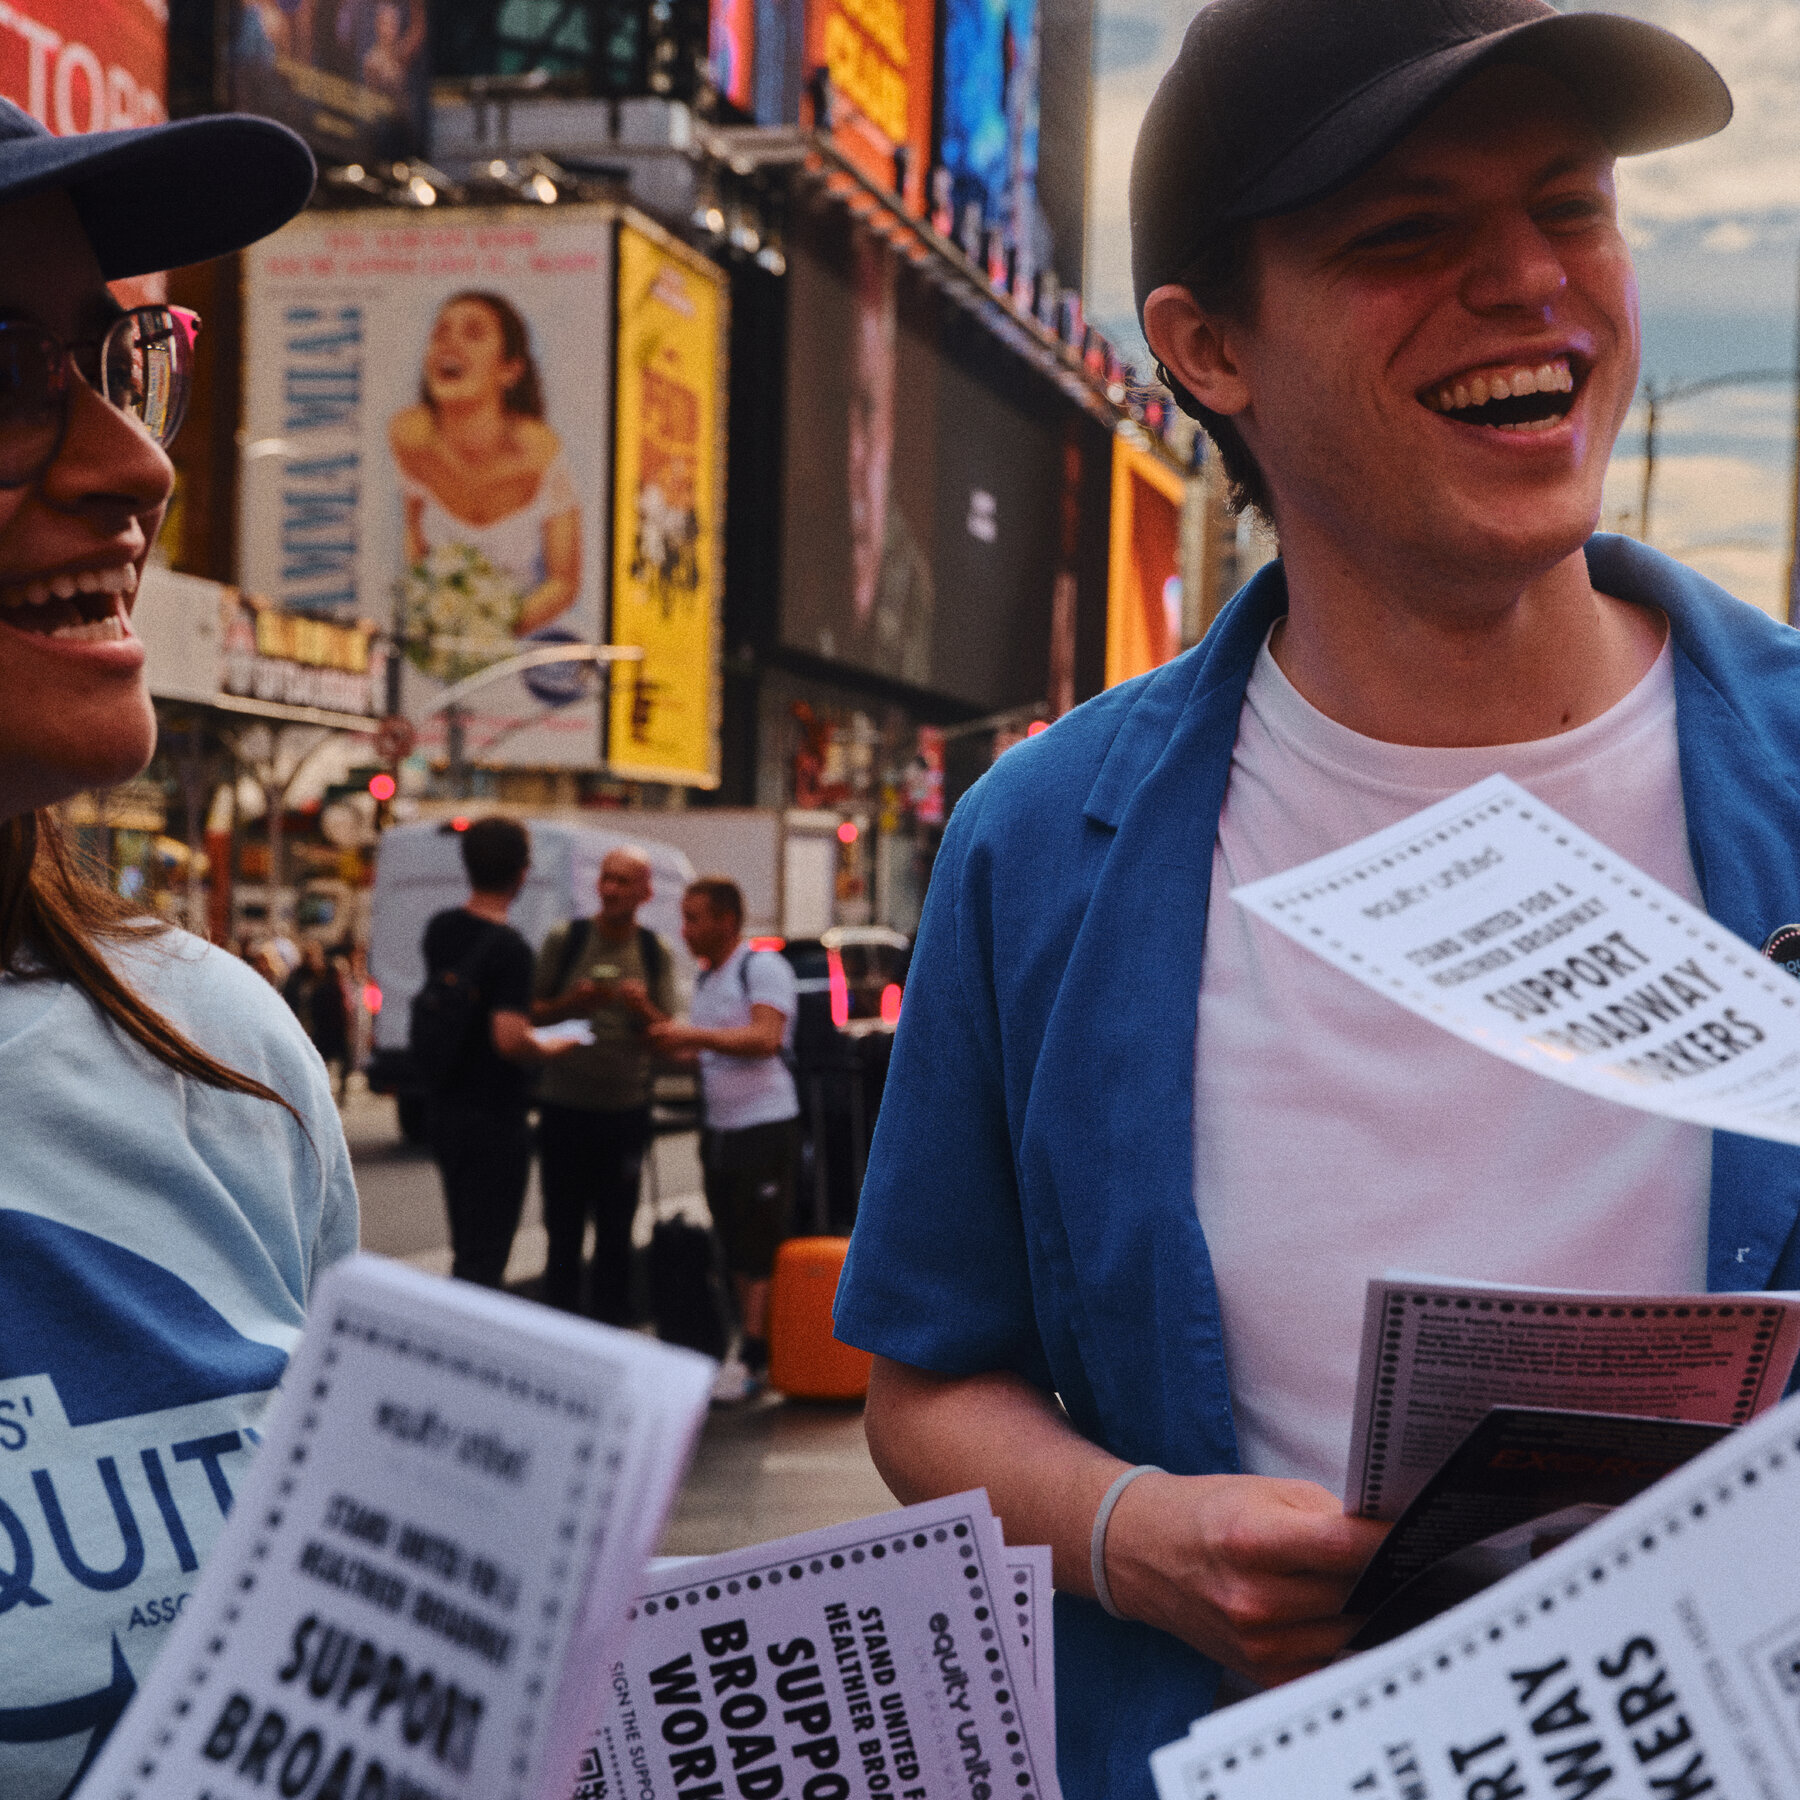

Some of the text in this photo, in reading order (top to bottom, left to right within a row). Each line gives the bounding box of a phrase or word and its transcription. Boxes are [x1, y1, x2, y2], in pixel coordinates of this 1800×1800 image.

[279, 454, 362, 612] AMMA
[1483, 930, 1651, 1023] SUPPORT
[1536, 957, 1722, 1056] ROADWAY
[277, 1611, 484, 1775] SUPPORT
[611, 1660, 633, 1706] SIGN
[766, 1637, 850, 1800] SUPPO
[824, 1602, 875, 1733] HEALTHIER
[857, 1606, 896, 1686] STAND
[879, 1692, 920, 1781] UNITED
[929, 1612, 972, 1713] equity
[621, 1709, 641, 1741] THE
